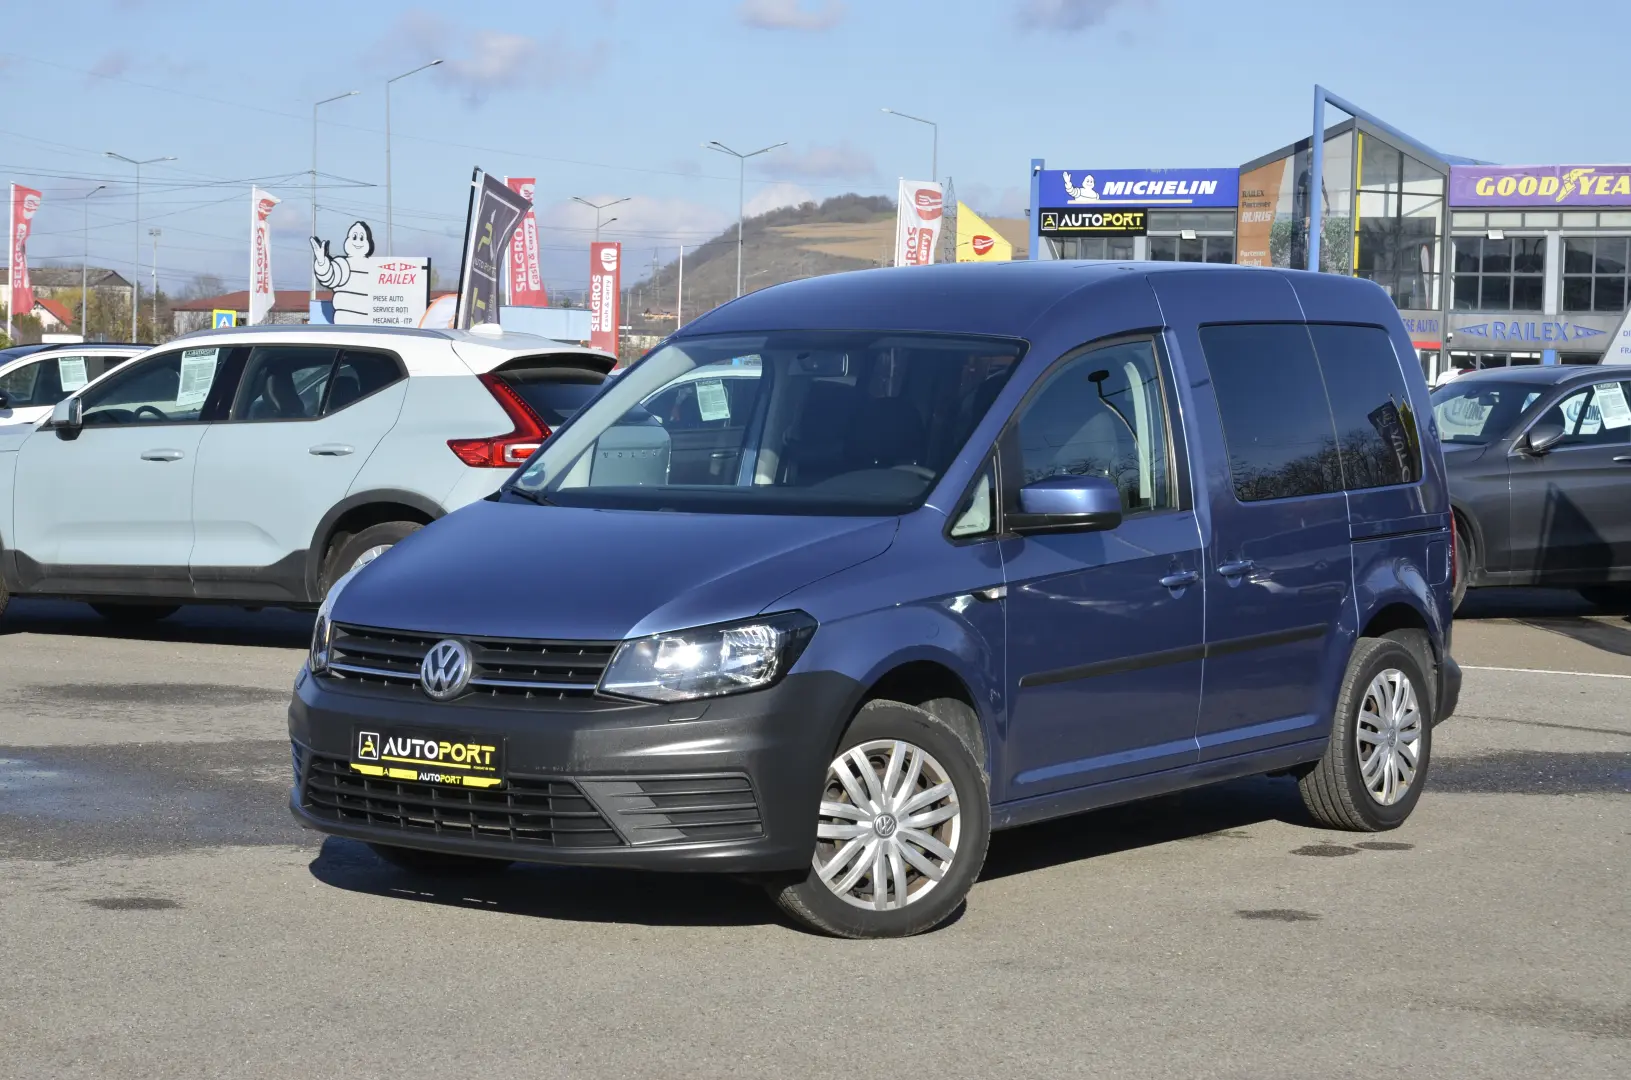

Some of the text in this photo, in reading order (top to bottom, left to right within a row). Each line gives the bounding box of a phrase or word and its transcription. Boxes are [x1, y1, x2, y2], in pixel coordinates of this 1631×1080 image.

[1102, 180, 1218, 196] MICHELIN
[1060, 213, 1144, 227] AUTOPORT
[905, 227, 917, 265] ROS
[513, 227, 527, 293] SELGRO
[378, 273, 417, 285] RAILEX
[591, 275, 601, 332] SELGROS
[1416, 318, 1439, 333] AUTO
[1491, 320, 1569, 342] RAILEX
[382, 736, 496, 765] AUTOPORT
[419, 772, 461, 784] AUTOPORT
